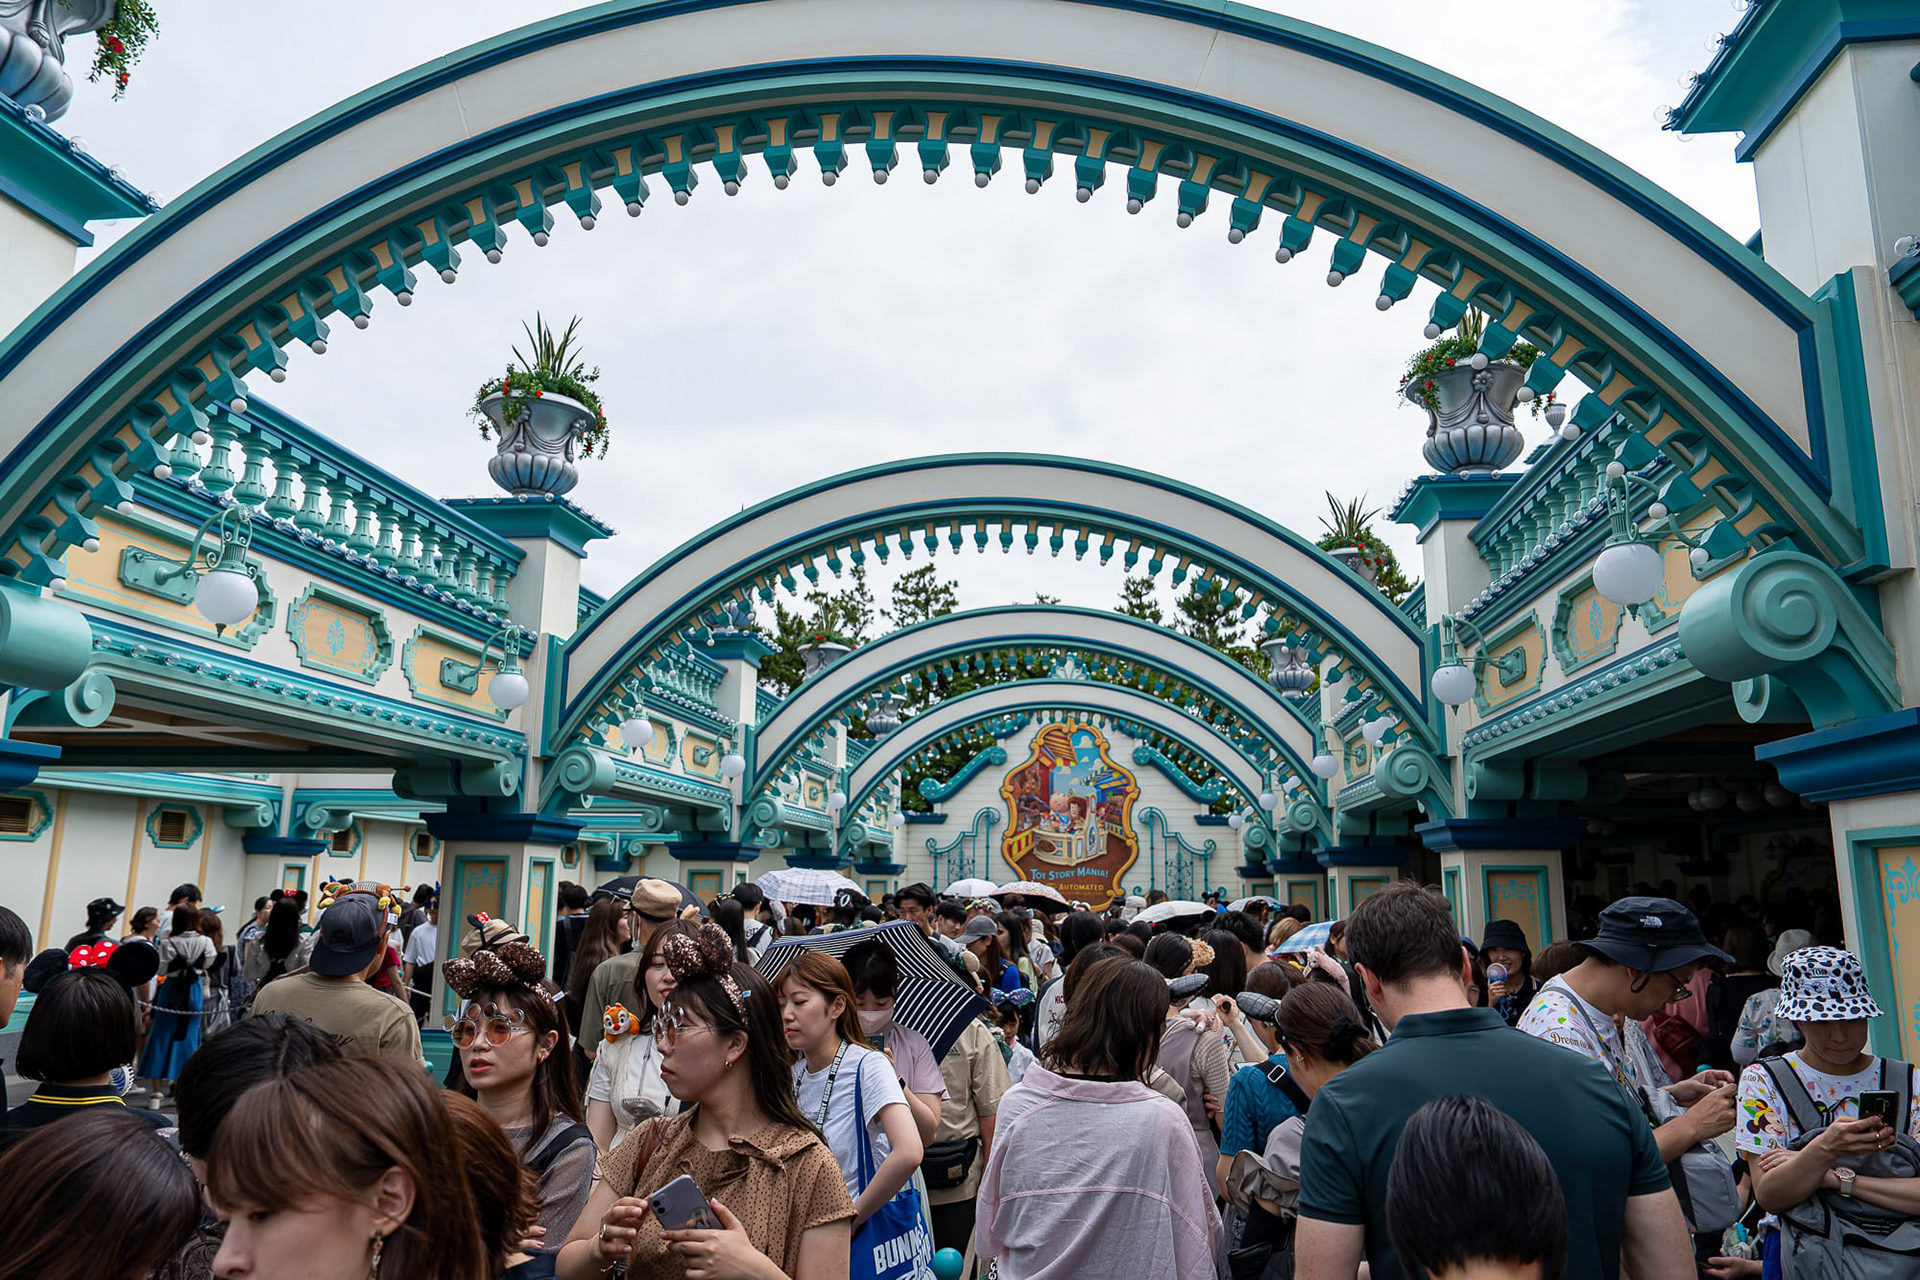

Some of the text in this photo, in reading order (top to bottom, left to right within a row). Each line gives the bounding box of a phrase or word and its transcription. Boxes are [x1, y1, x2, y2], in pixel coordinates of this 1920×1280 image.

[1029, 867, 1109, 880] TOY STORY MANIA!
[1058, 883, 1104, 891] AUTOMATED
